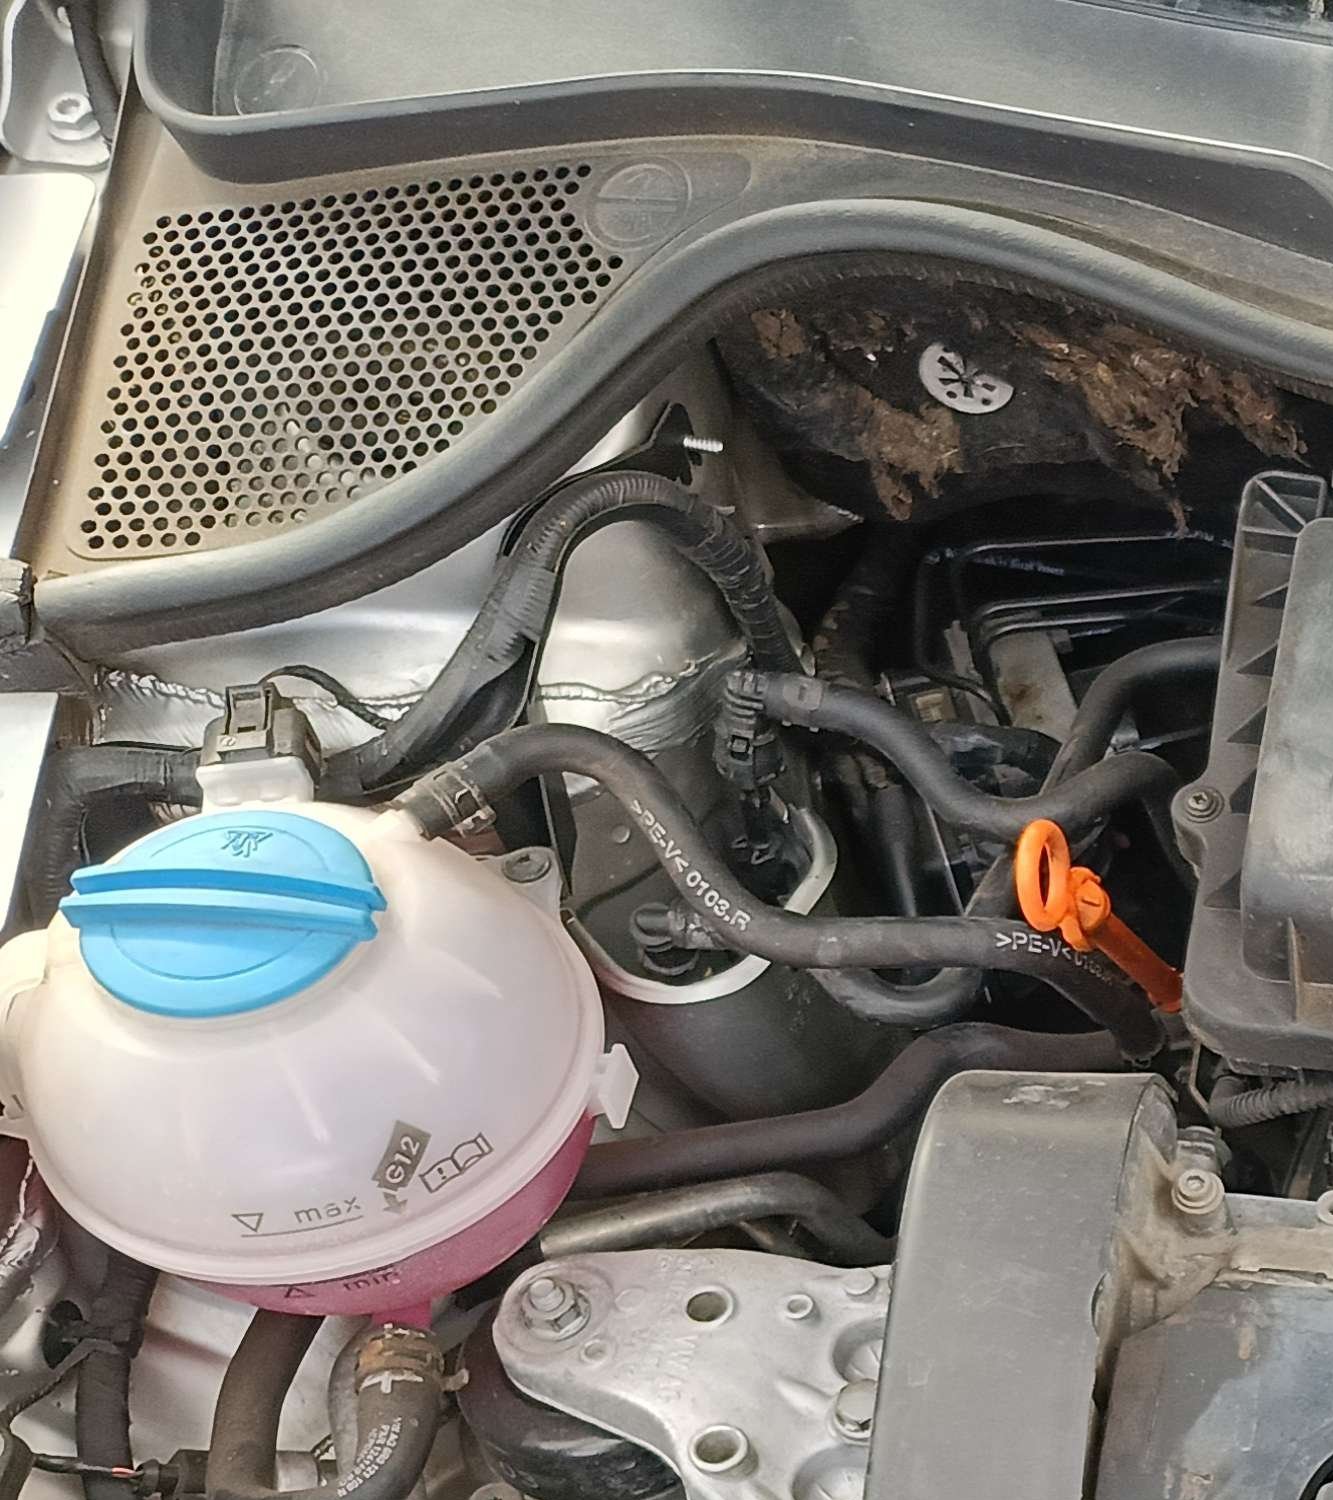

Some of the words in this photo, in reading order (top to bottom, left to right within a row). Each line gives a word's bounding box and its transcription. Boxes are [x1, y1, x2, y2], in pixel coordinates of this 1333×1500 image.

[995, 930, 1073, 967] >PE-V<
[384, 1134, 420, 1185] G12
[293, 1196, 362, 1224] max
